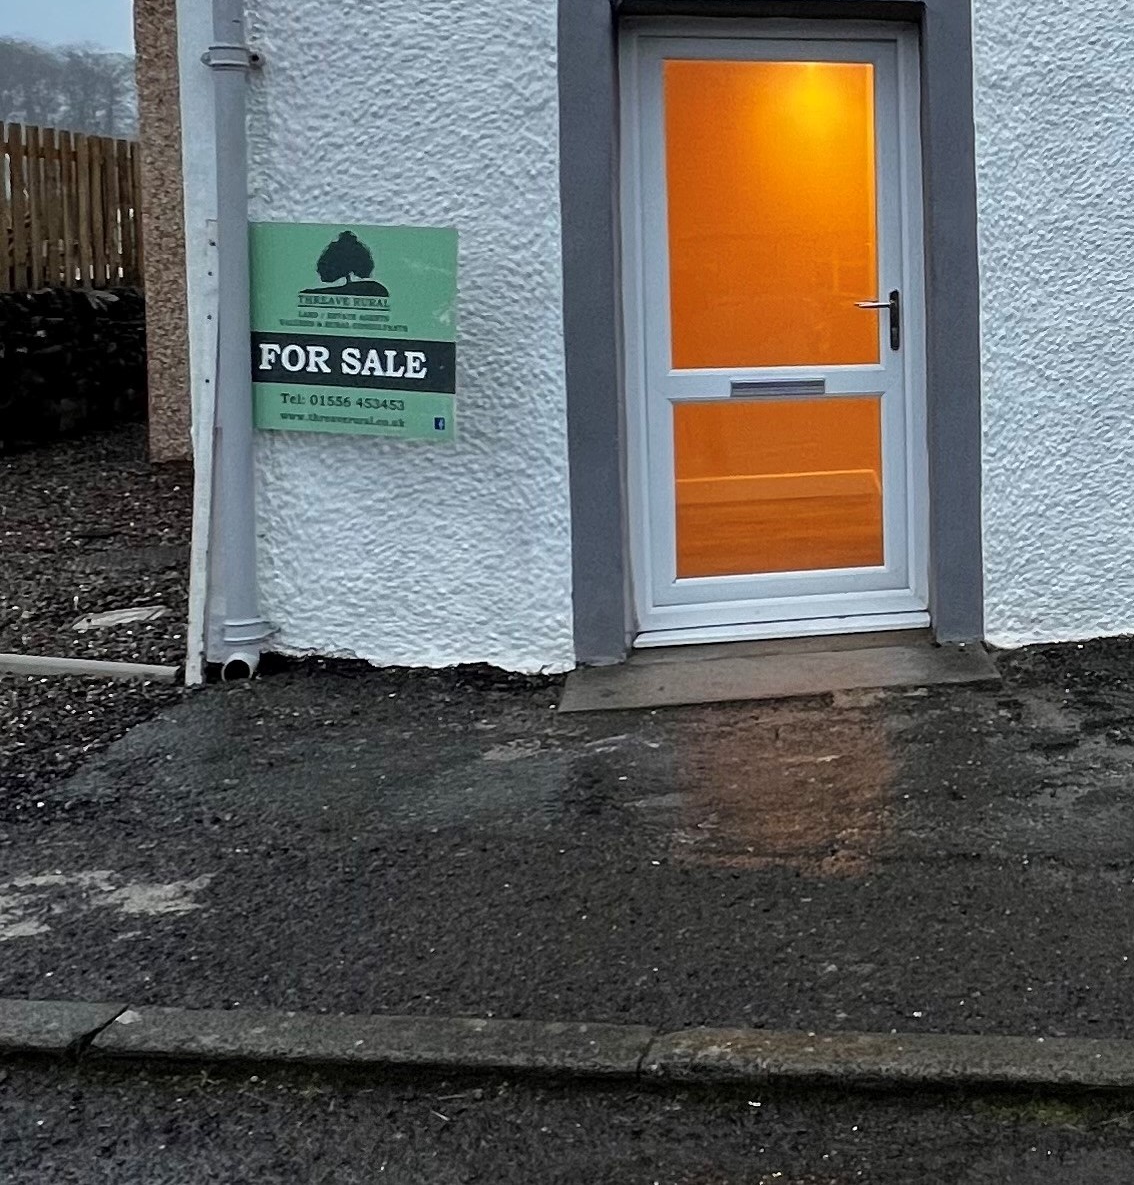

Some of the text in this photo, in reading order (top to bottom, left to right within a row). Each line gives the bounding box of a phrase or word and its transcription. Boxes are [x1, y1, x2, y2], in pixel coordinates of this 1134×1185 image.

[353, 298, 390, 307] RURAL
[258, 343, 428, 379] FOR SALE
[310, 394, 351, 407] 01556
[356, 398, 405, 410] 453453
